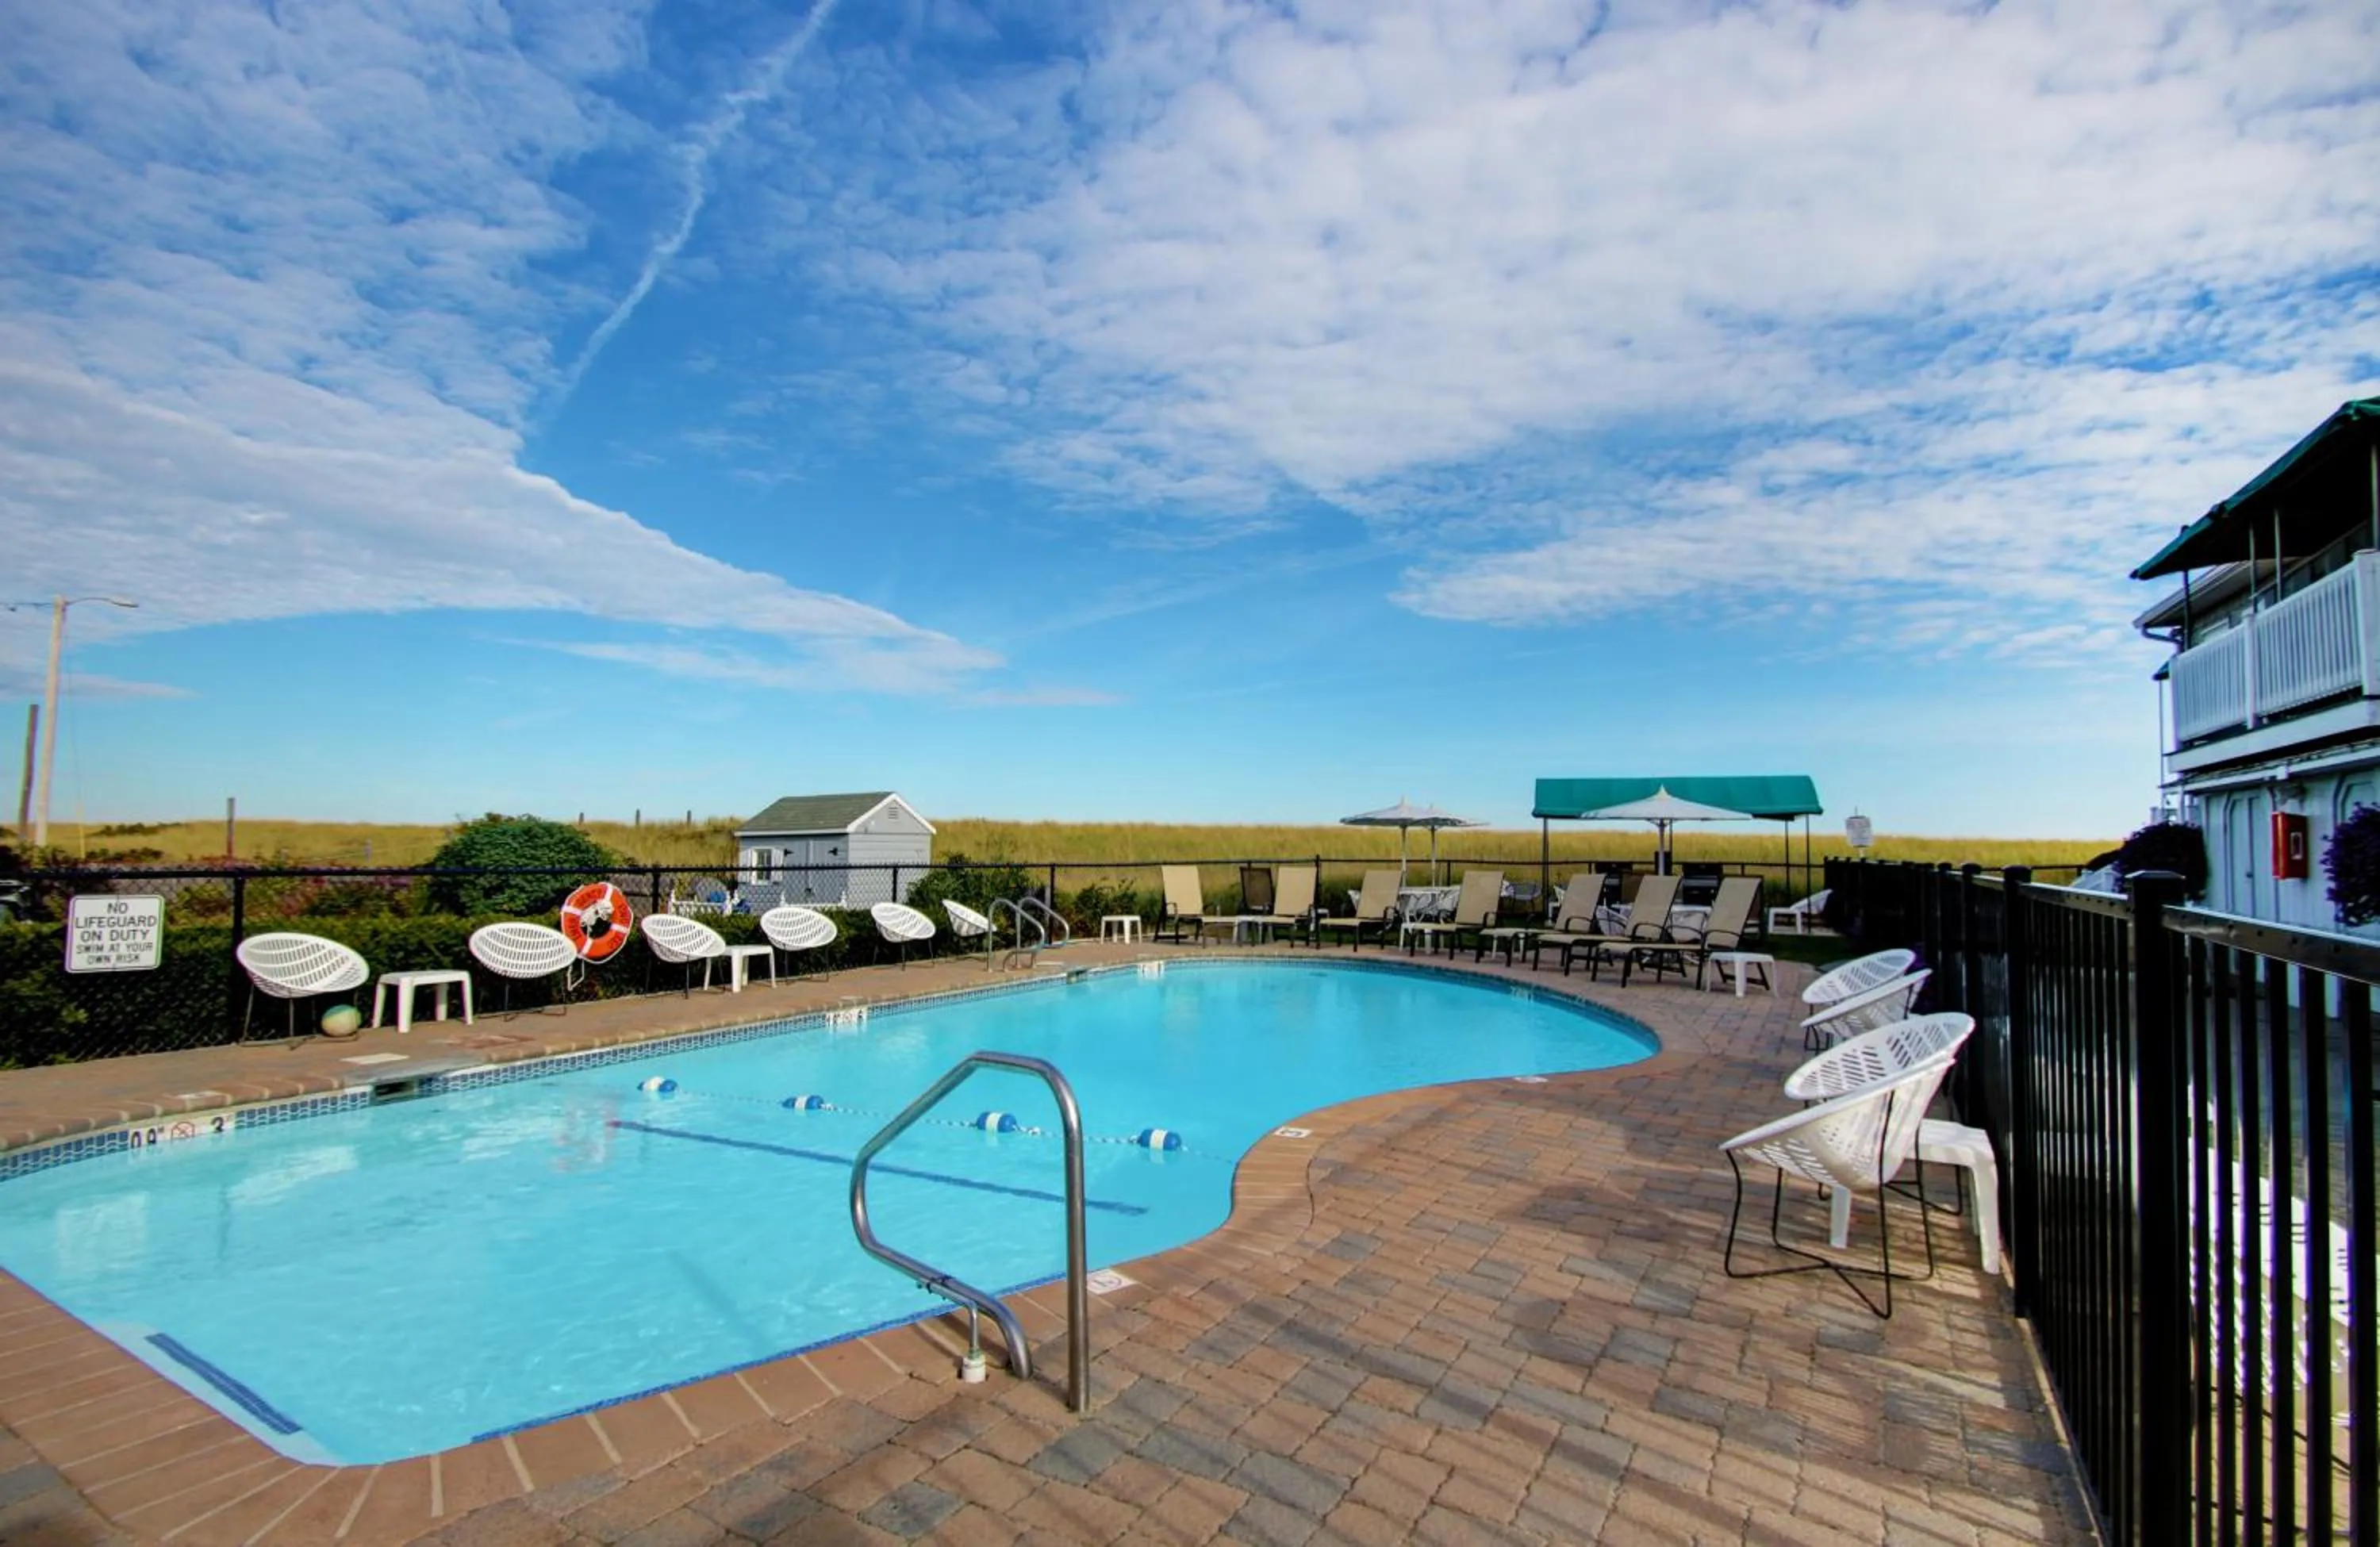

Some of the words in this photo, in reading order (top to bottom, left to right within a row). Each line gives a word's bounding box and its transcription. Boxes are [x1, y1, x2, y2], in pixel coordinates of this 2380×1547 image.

[107, 903, 128, 914] NO
[75, 916, 157, 928] LIFEGUARD
[80, 930, 102, 942] ON
[109, 929, 150, 941] DUTY
[76, 944, 104, 954] SWIM
[109, 943, 121, 952] AT
[126, 942, 153, 952] YOUR
[87, 955, 110, 965] OWN
[116, 954, 140, 963] RISK
